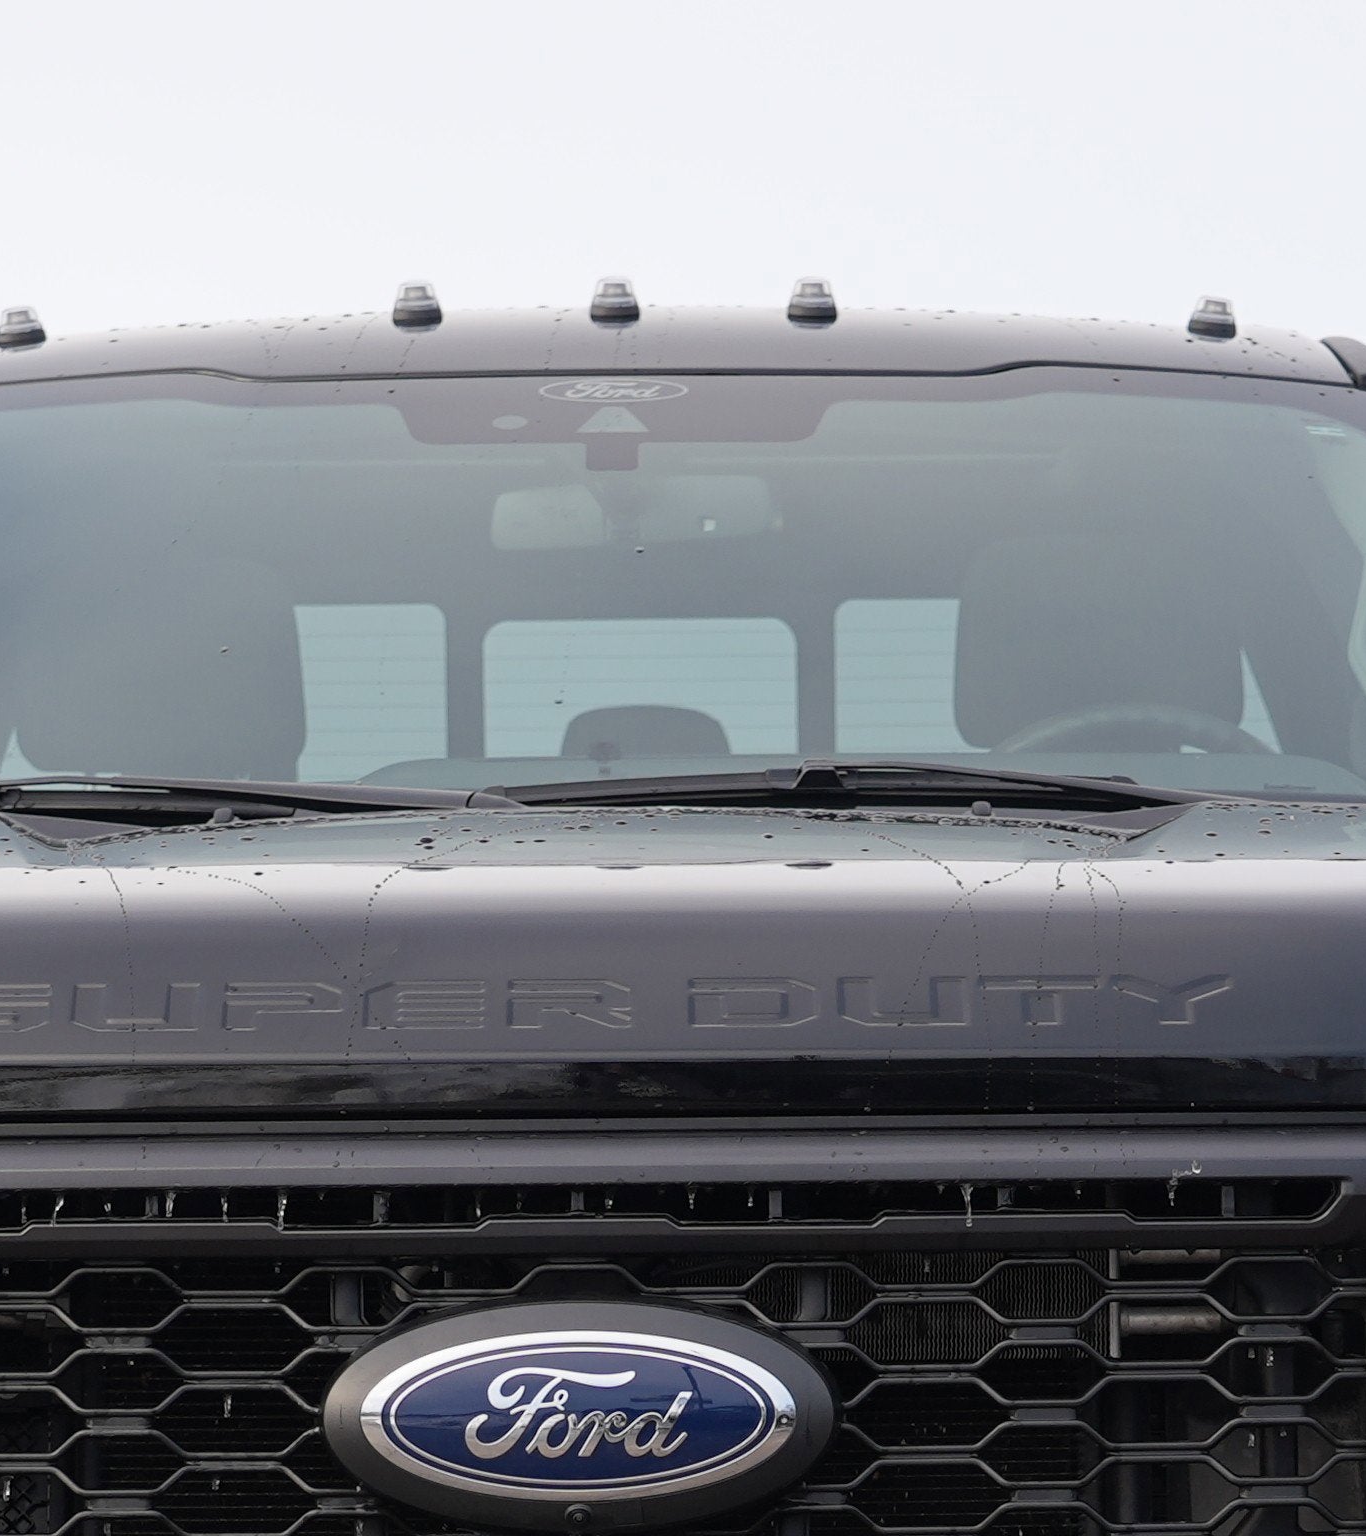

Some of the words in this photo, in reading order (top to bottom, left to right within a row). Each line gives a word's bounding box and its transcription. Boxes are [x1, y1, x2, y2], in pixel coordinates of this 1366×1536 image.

[564, 380, 660, 400] Ford
[687, 973, 1233, 1028] DUTY
[463, 1366, 694, 1460] Ford
